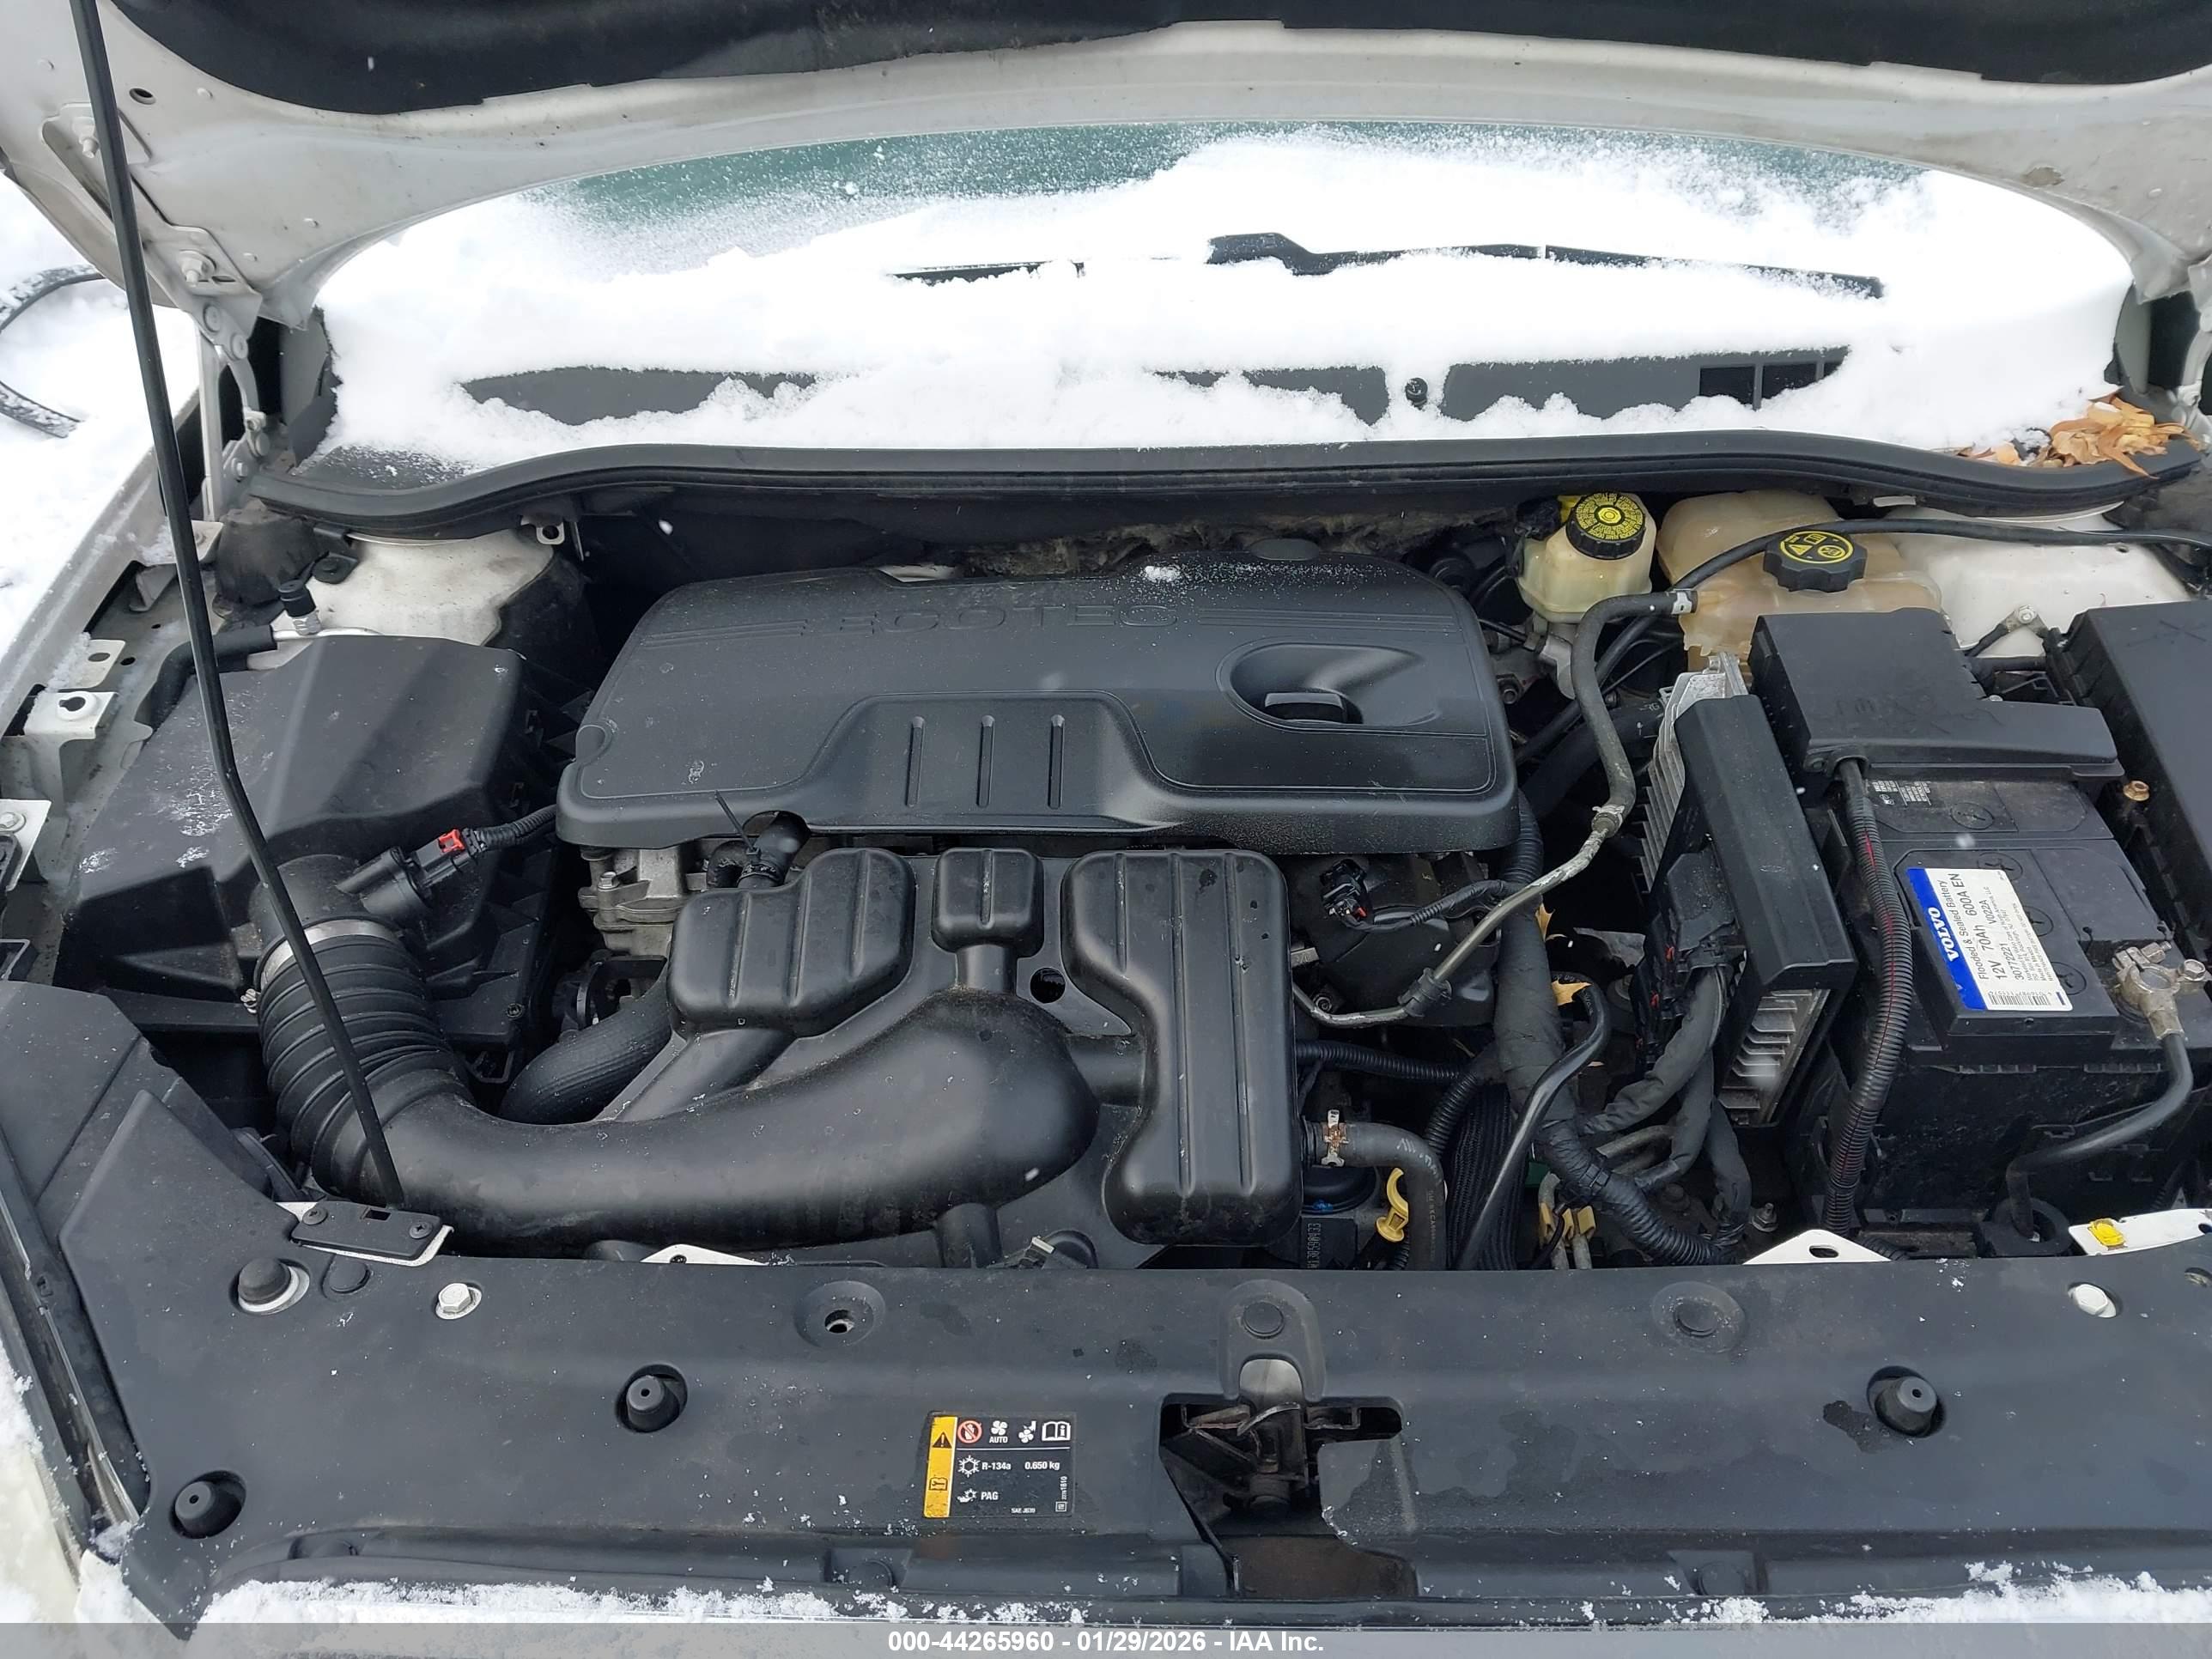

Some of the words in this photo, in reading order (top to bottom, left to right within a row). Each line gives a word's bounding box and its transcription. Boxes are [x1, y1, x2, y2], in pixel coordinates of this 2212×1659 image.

[1948, 873, 1965, 887] EN
[1937, 880, 1956, 907] Battery
[1957, 890, 1978, 915] 600A
[1948, 910, 1969, 936] Sealed
[1978, 900, 1997, 924] V022A
[1929, 908, 1959, 961] VOLVO
[1973, 925, 1994, 951] 70Ah
[1966, 946, 1989, 979] Flooded
[1988, 960, 2007, 980] 12V
[1999, 944, 2024, 980] 30772221
[981, 1462, 1012, 1470] R-134a
[1024, 1462, 1048, 1470] 0.650
[1049, 1462, 1060, 1471] kg
[981, 1491, 999, 1501] PAG
